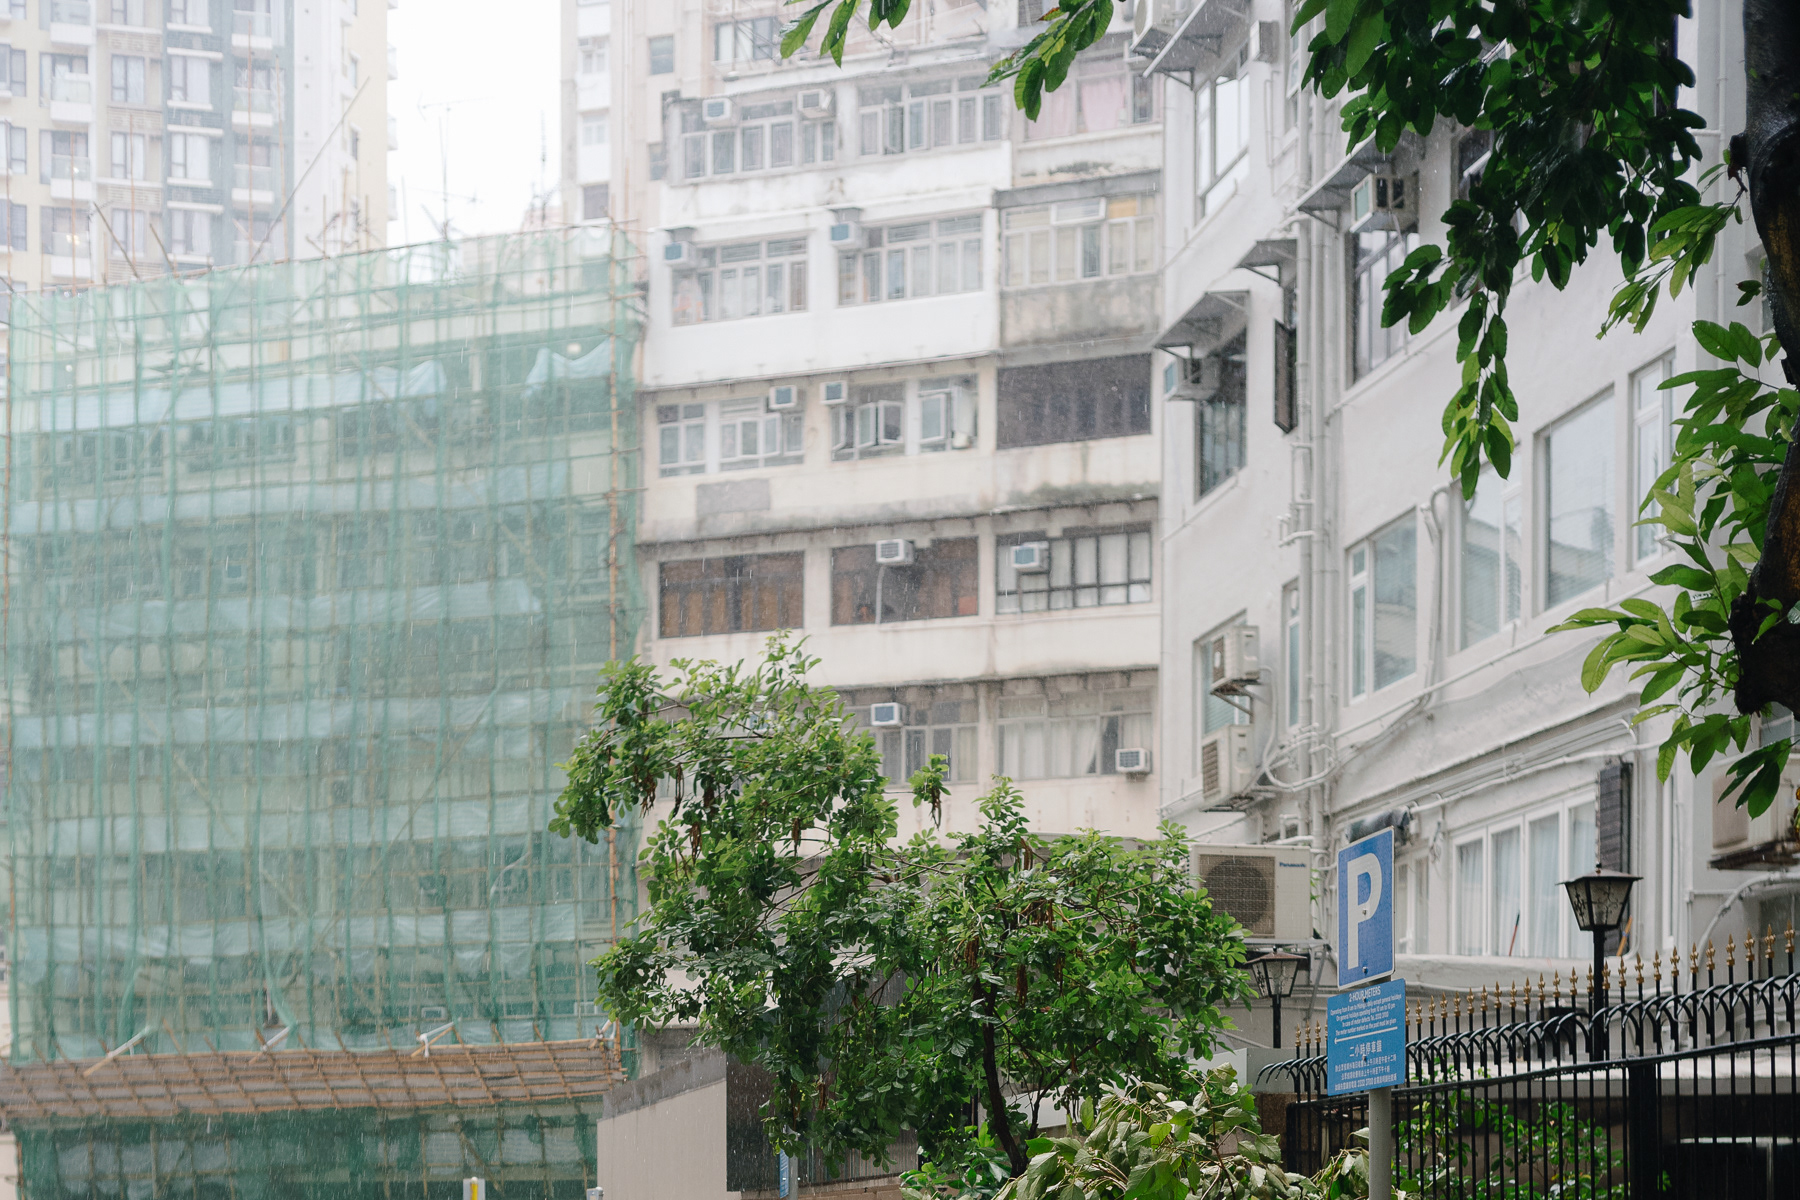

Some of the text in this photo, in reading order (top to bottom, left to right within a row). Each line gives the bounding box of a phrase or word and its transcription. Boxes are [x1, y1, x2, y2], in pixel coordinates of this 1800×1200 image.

[1347, 853, 1383, 970] P
[1349, 986, 1381, 1002] 2-HOUR METERS
